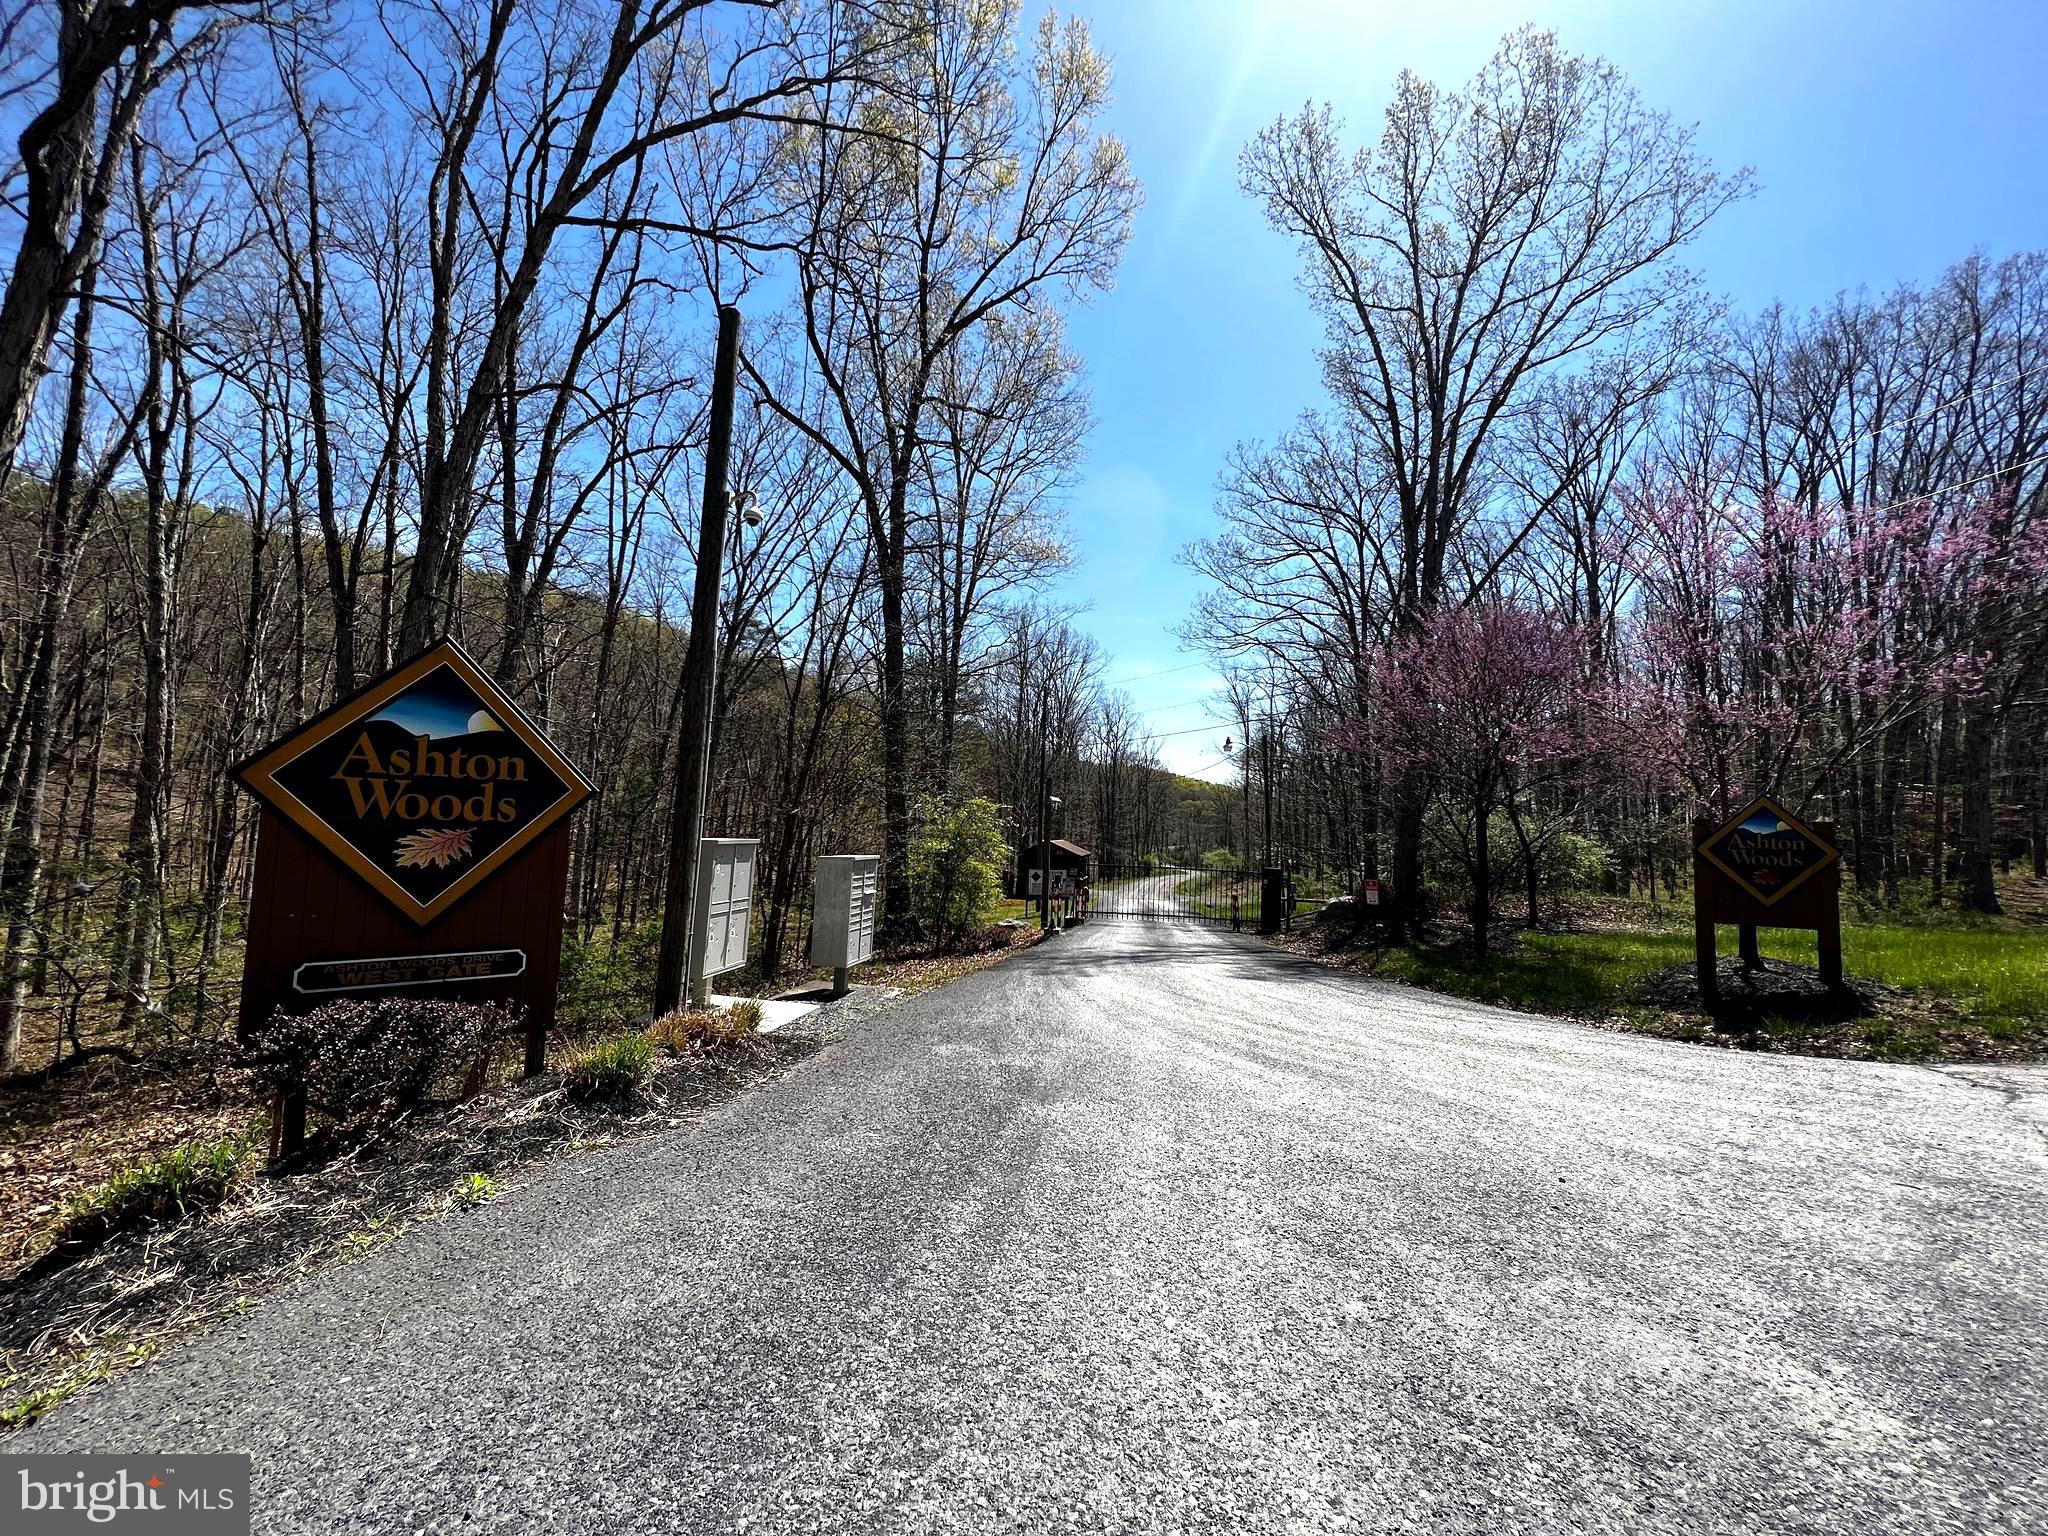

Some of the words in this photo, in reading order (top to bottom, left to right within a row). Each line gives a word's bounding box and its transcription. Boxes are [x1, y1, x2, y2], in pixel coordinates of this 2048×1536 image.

[330, 732, 528, 782] Ashton
[338, 775, 517, 823] Woods
[1727, 832, 1806, 851] Ashton
[1730, 848, 1805, 867] Woods
[323, 961, 392, 974] ASHTON
[398, 956, 457, 968] WOODS
[463, 953, 504, 964] DRIVE
[338, 968, 416, 986] WEST
[428, 962, 492, 979] GATE
